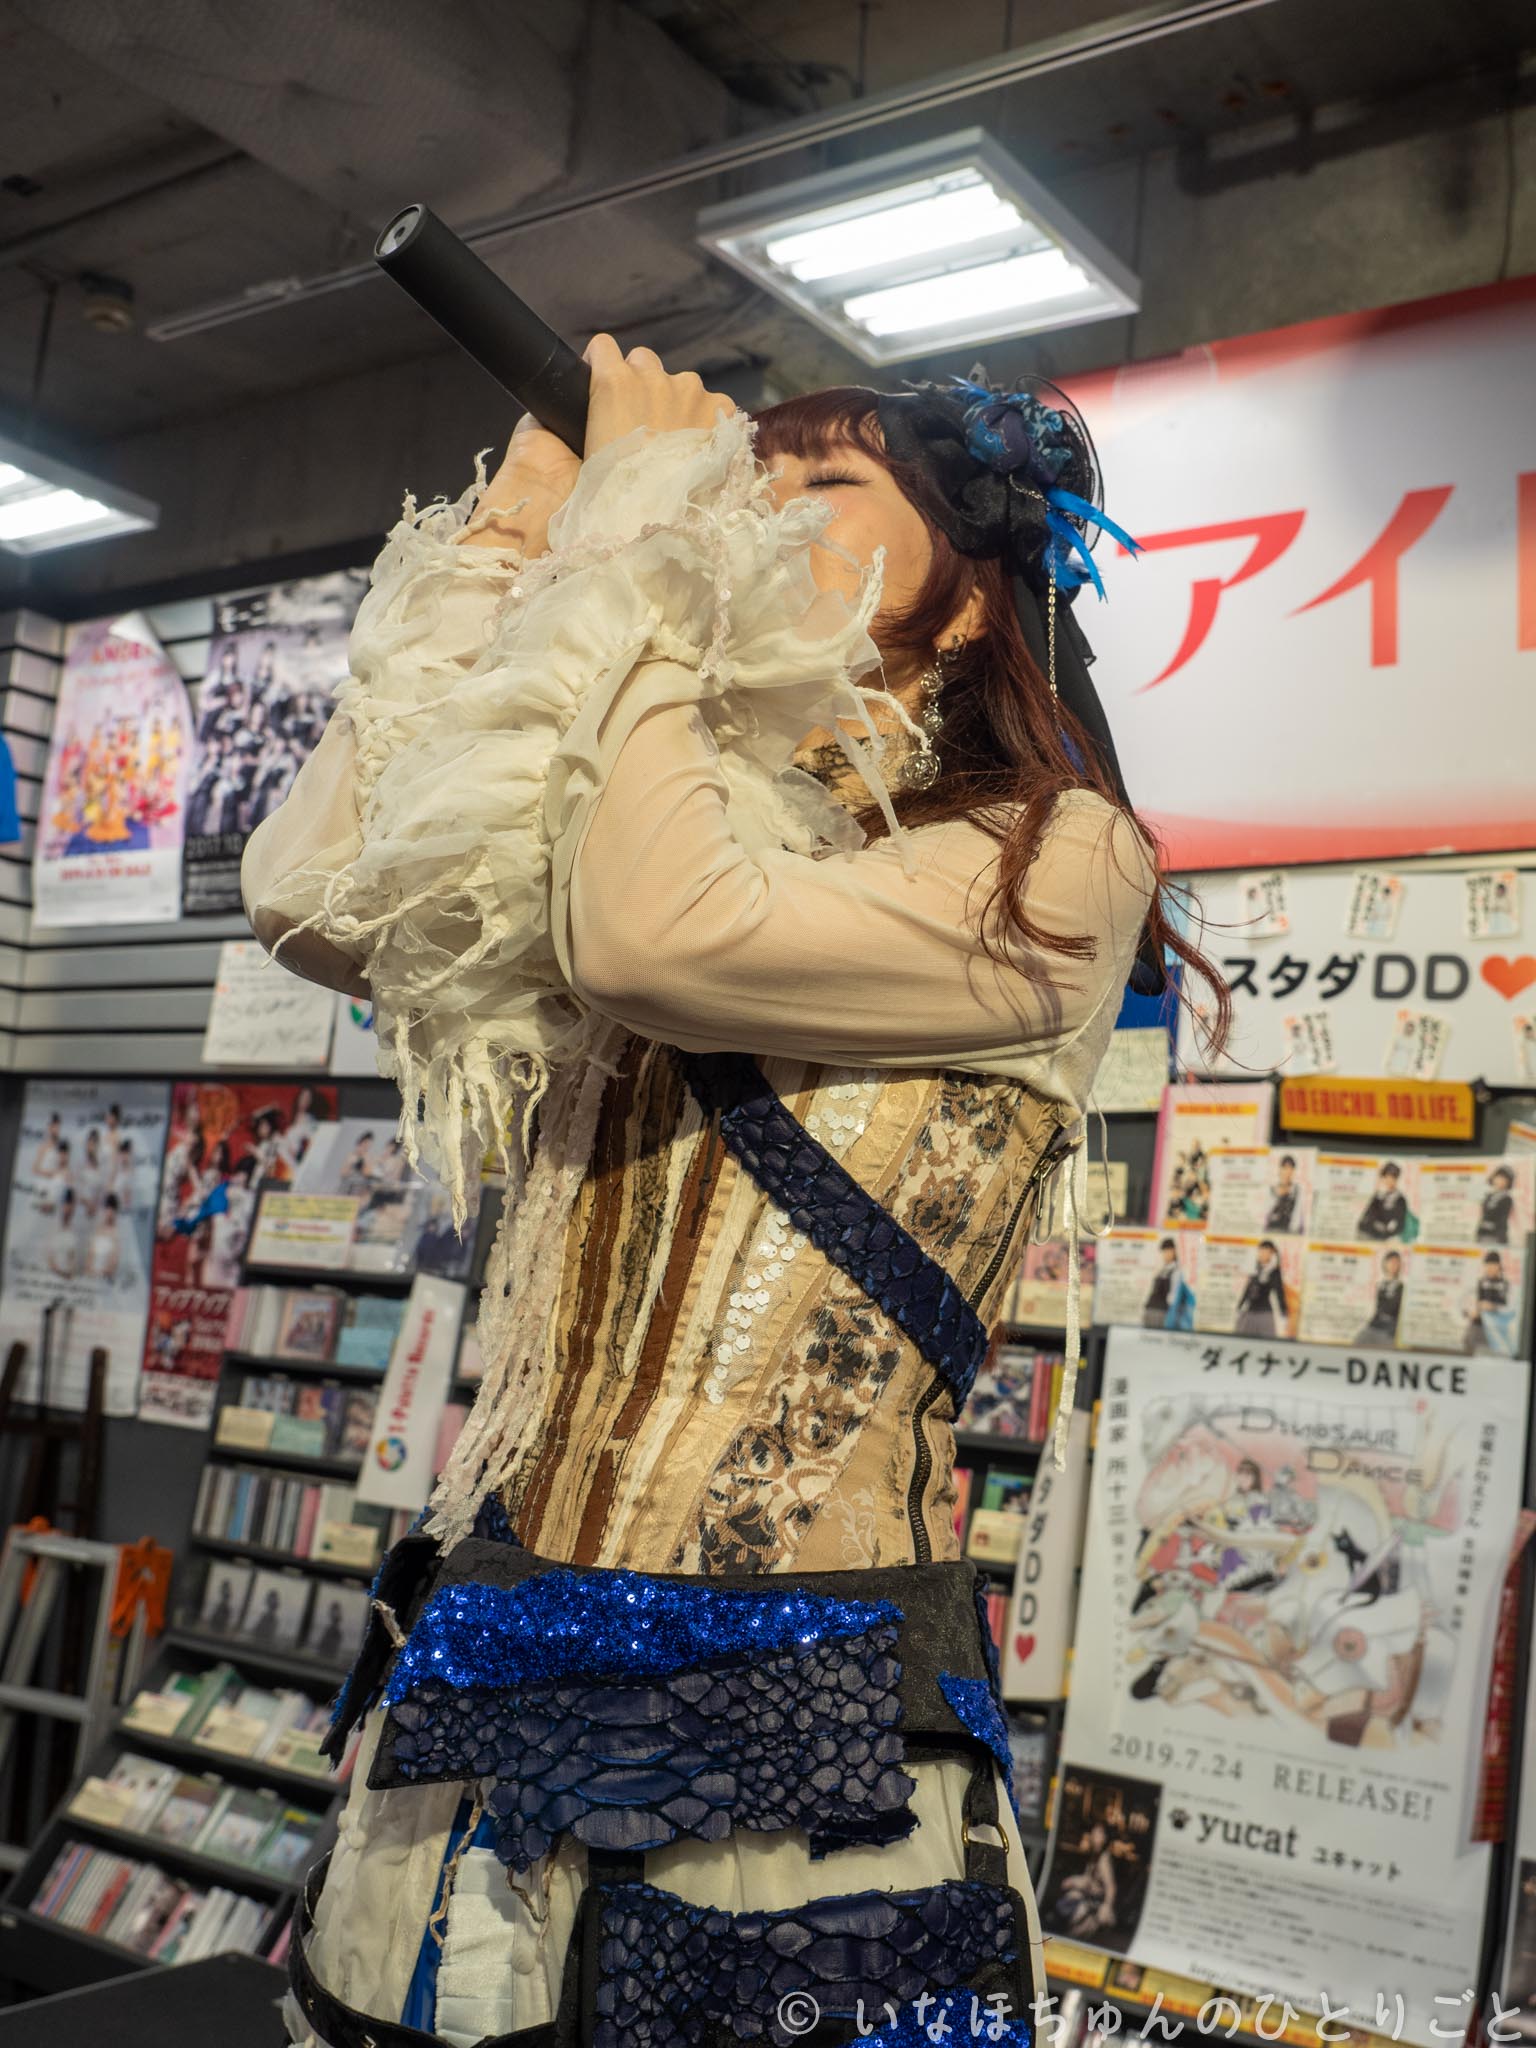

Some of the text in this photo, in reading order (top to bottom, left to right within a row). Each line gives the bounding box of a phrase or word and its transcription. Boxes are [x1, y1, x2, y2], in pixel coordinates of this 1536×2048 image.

[1116, 471, 1536, 696] アイ
[1222, 953, 1470, 1001] スタダDD
[1201, 1346, 1469, 1395] ダイナソーDANCE
[1109, 1732, 1244, 1781] 2019.7.24
[1273, 1762, 1435, 1823] RELEASE!
[1195, 1812, 1299, 1858] yucat
